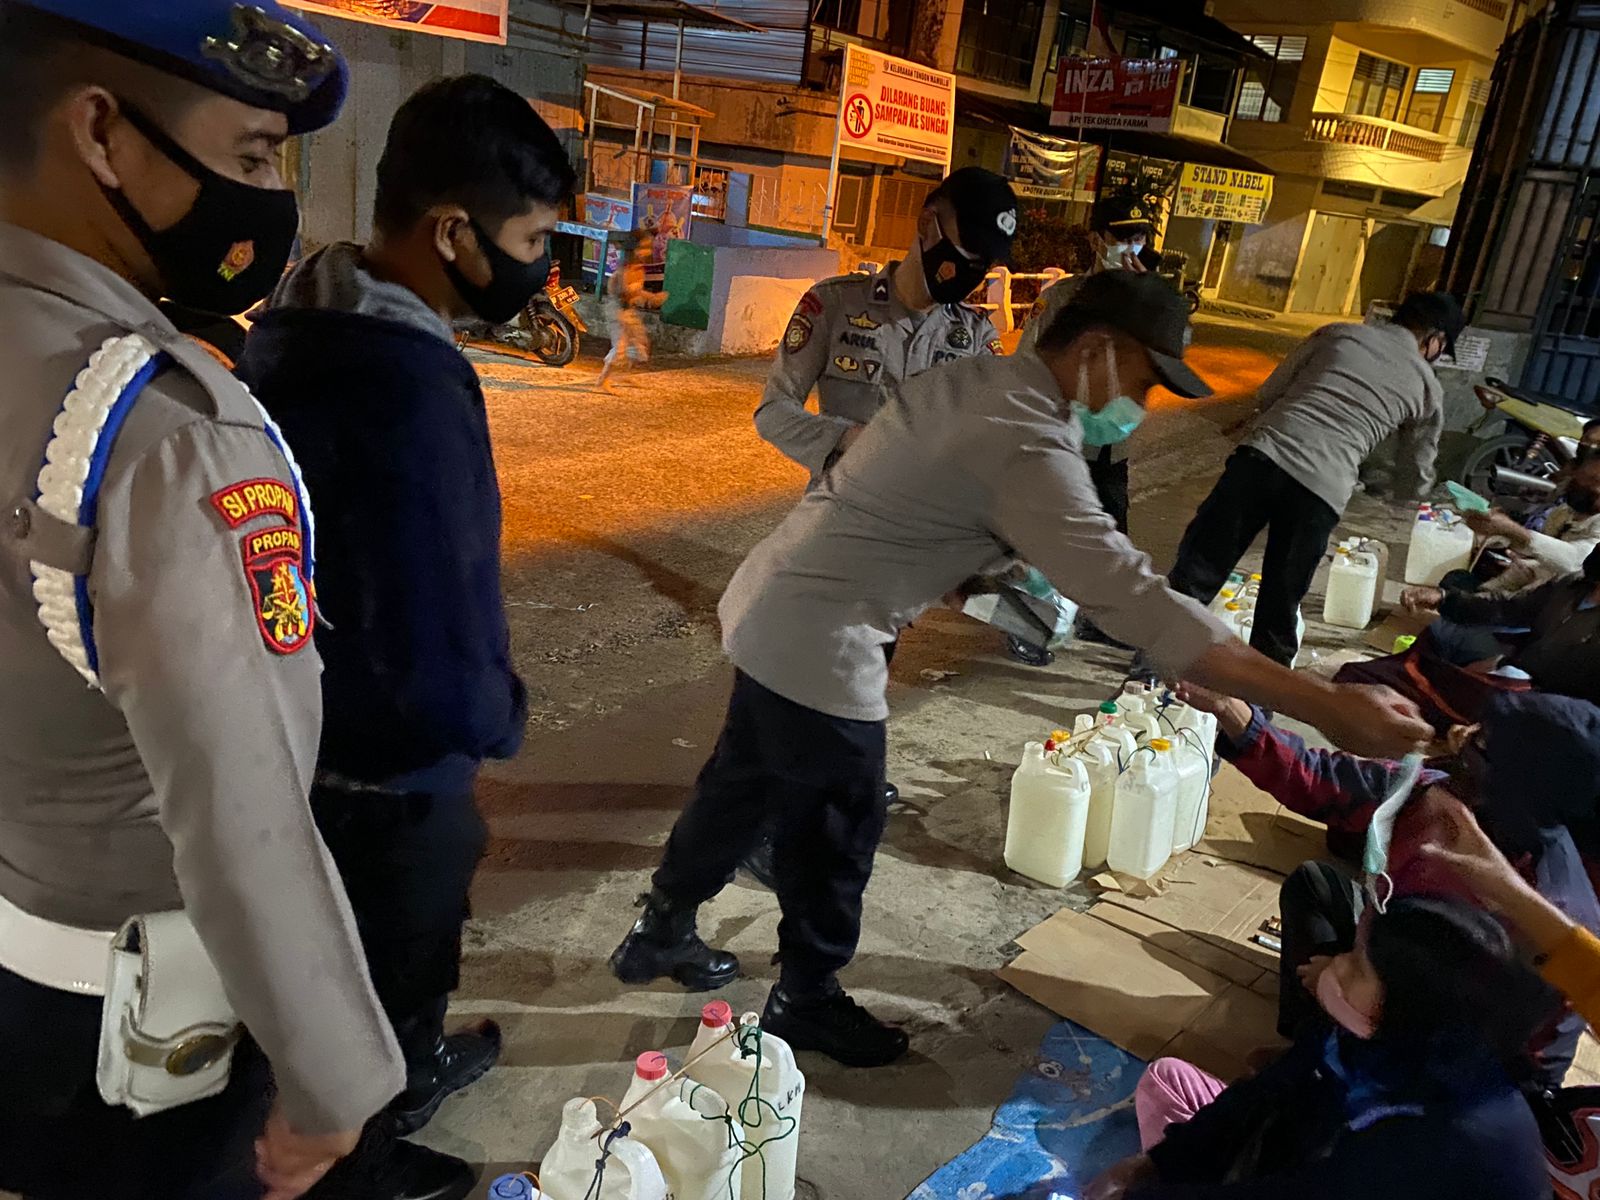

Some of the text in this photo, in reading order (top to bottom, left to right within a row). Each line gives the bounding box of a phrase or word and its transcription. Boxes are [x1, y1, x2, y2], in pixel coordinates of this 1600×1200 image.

[1064, 69, 1114, 95] INZA
[880, 85, 946, 117] DILARANG BUANG
[874, 103, 949, 136] SAMPAH KE SUNGAI
[1122, 118, 1149, 128] FARMA
[1192, 166, 1265, 191] STAND NABEL
[222, 491, 247, 519] SI
